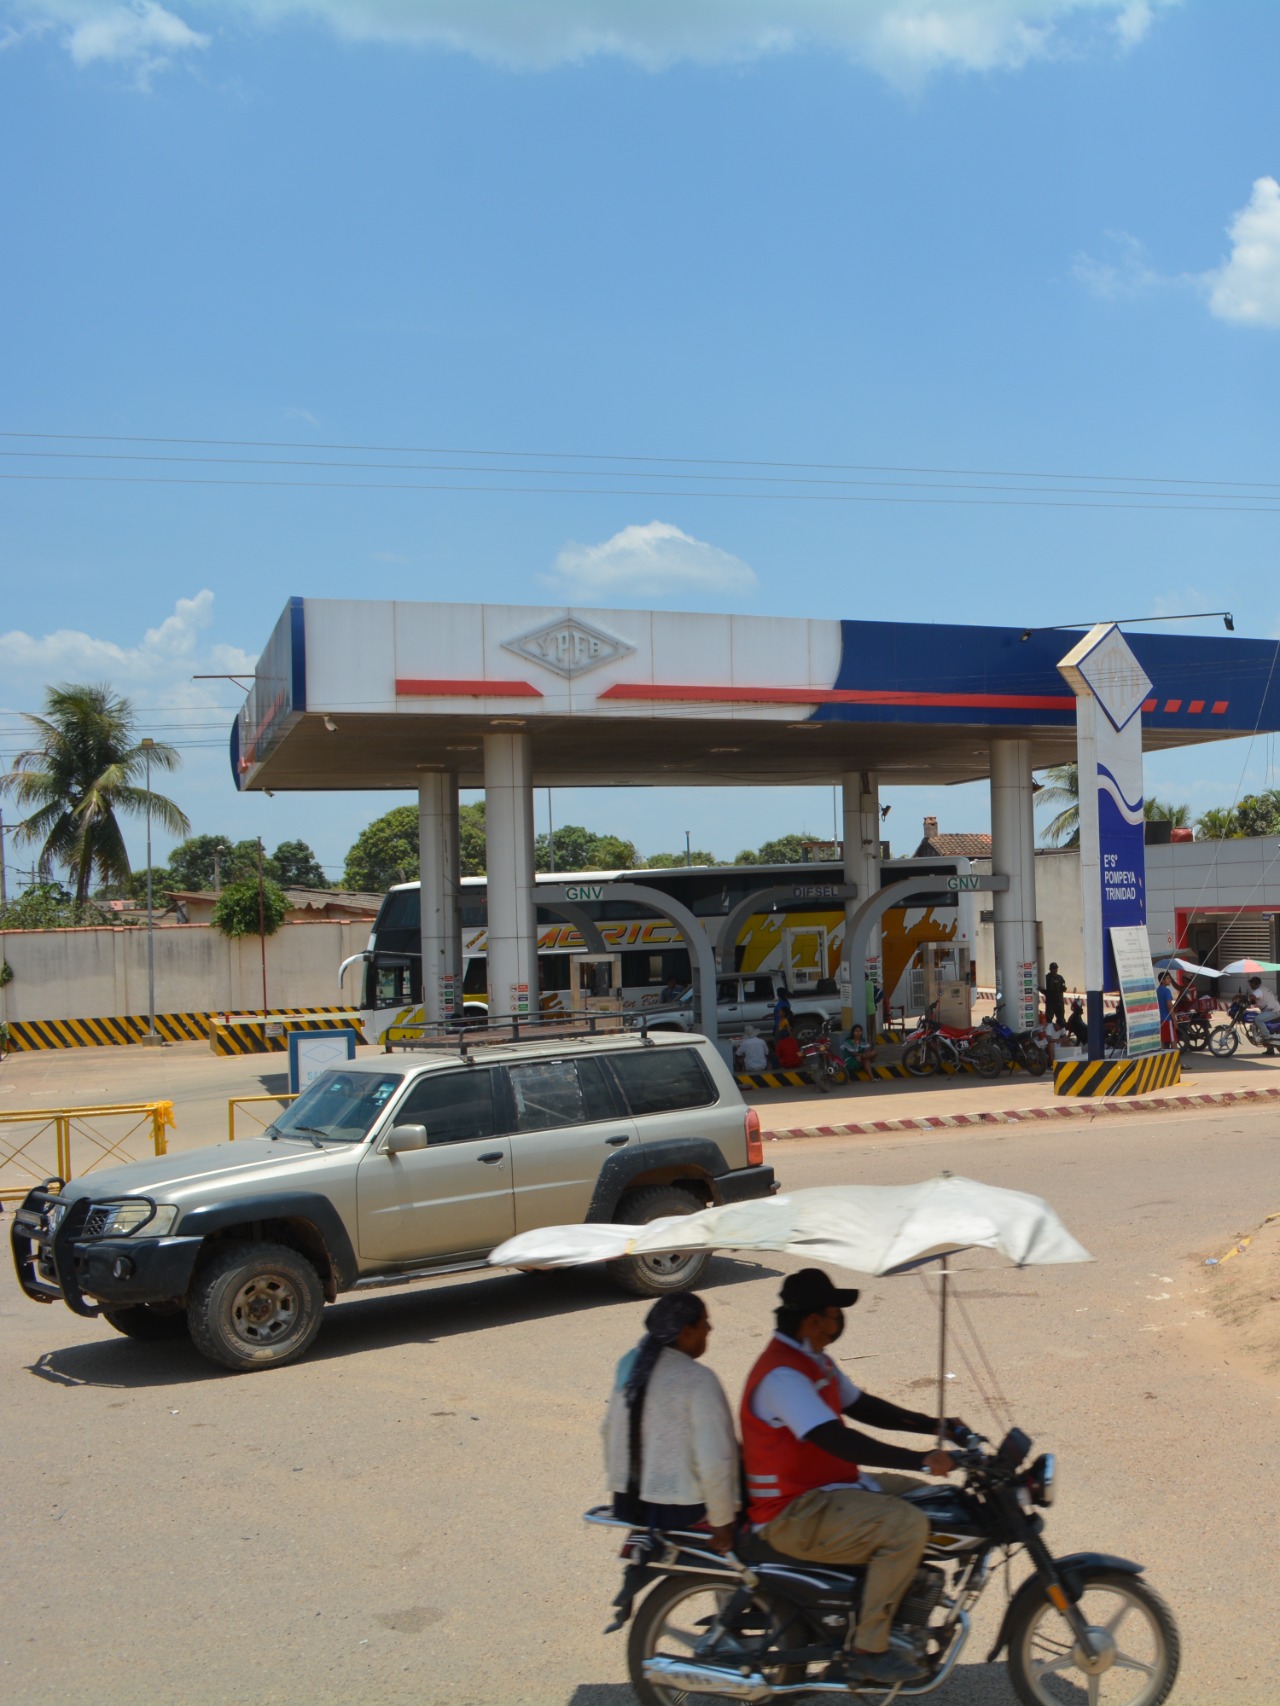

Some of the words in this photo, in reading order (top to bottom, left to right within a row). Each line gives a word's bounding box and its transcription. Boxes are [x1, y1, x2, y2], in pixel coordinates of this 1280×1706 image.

[537, 630, 600, 665] YPFB
[947, 876, 979, 890] GNV
[1104, 871, 1136, 884] POMPEYA
[565, 887, 603, 900] GNV
[1105, 887, 1136, 901] TRINIDAD
